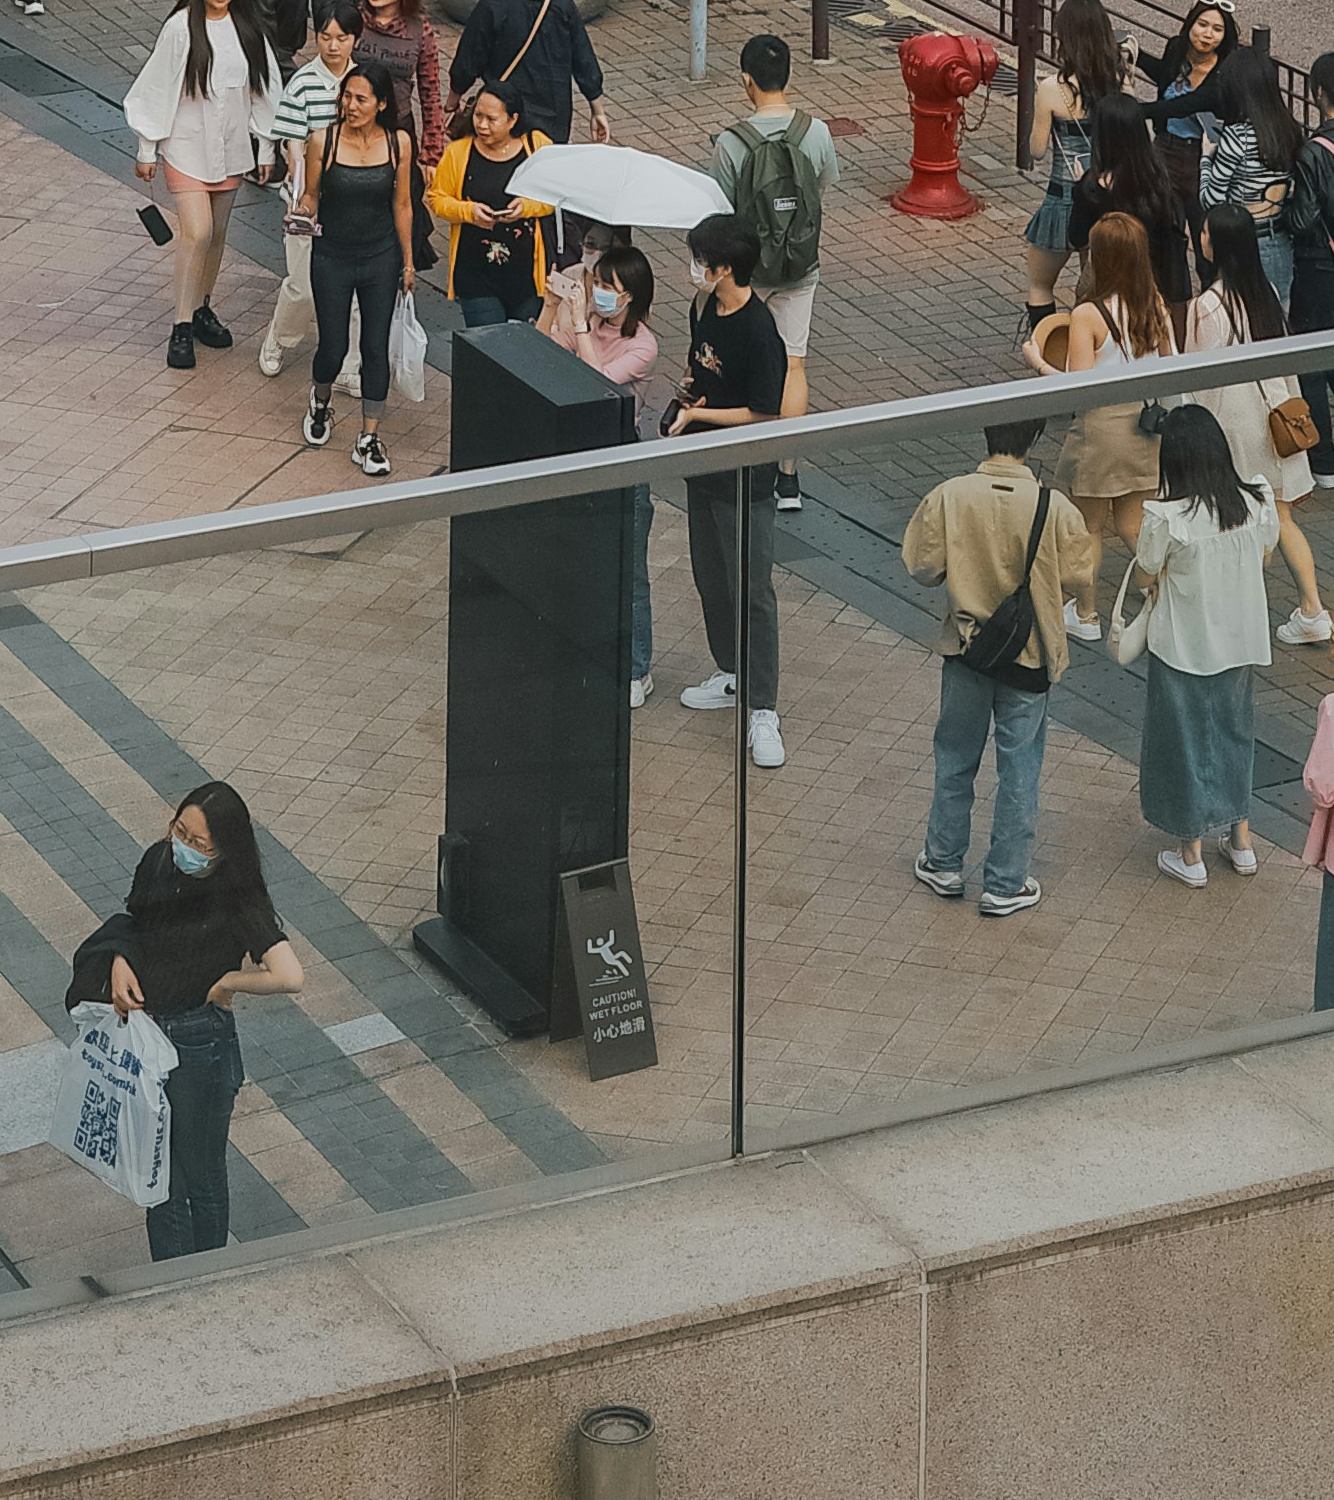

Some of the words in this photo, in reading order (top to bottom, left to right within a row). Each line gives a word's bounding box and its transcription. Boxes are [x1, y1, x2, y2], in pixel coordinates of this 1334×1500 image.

[592, 987, 637, 1008] CAUTION!
[589, 1008, 609, 1021] WET
[611, 1000, 644, 1015] FLOOR
[593, 1016, 646, 1043] 小心地滑
